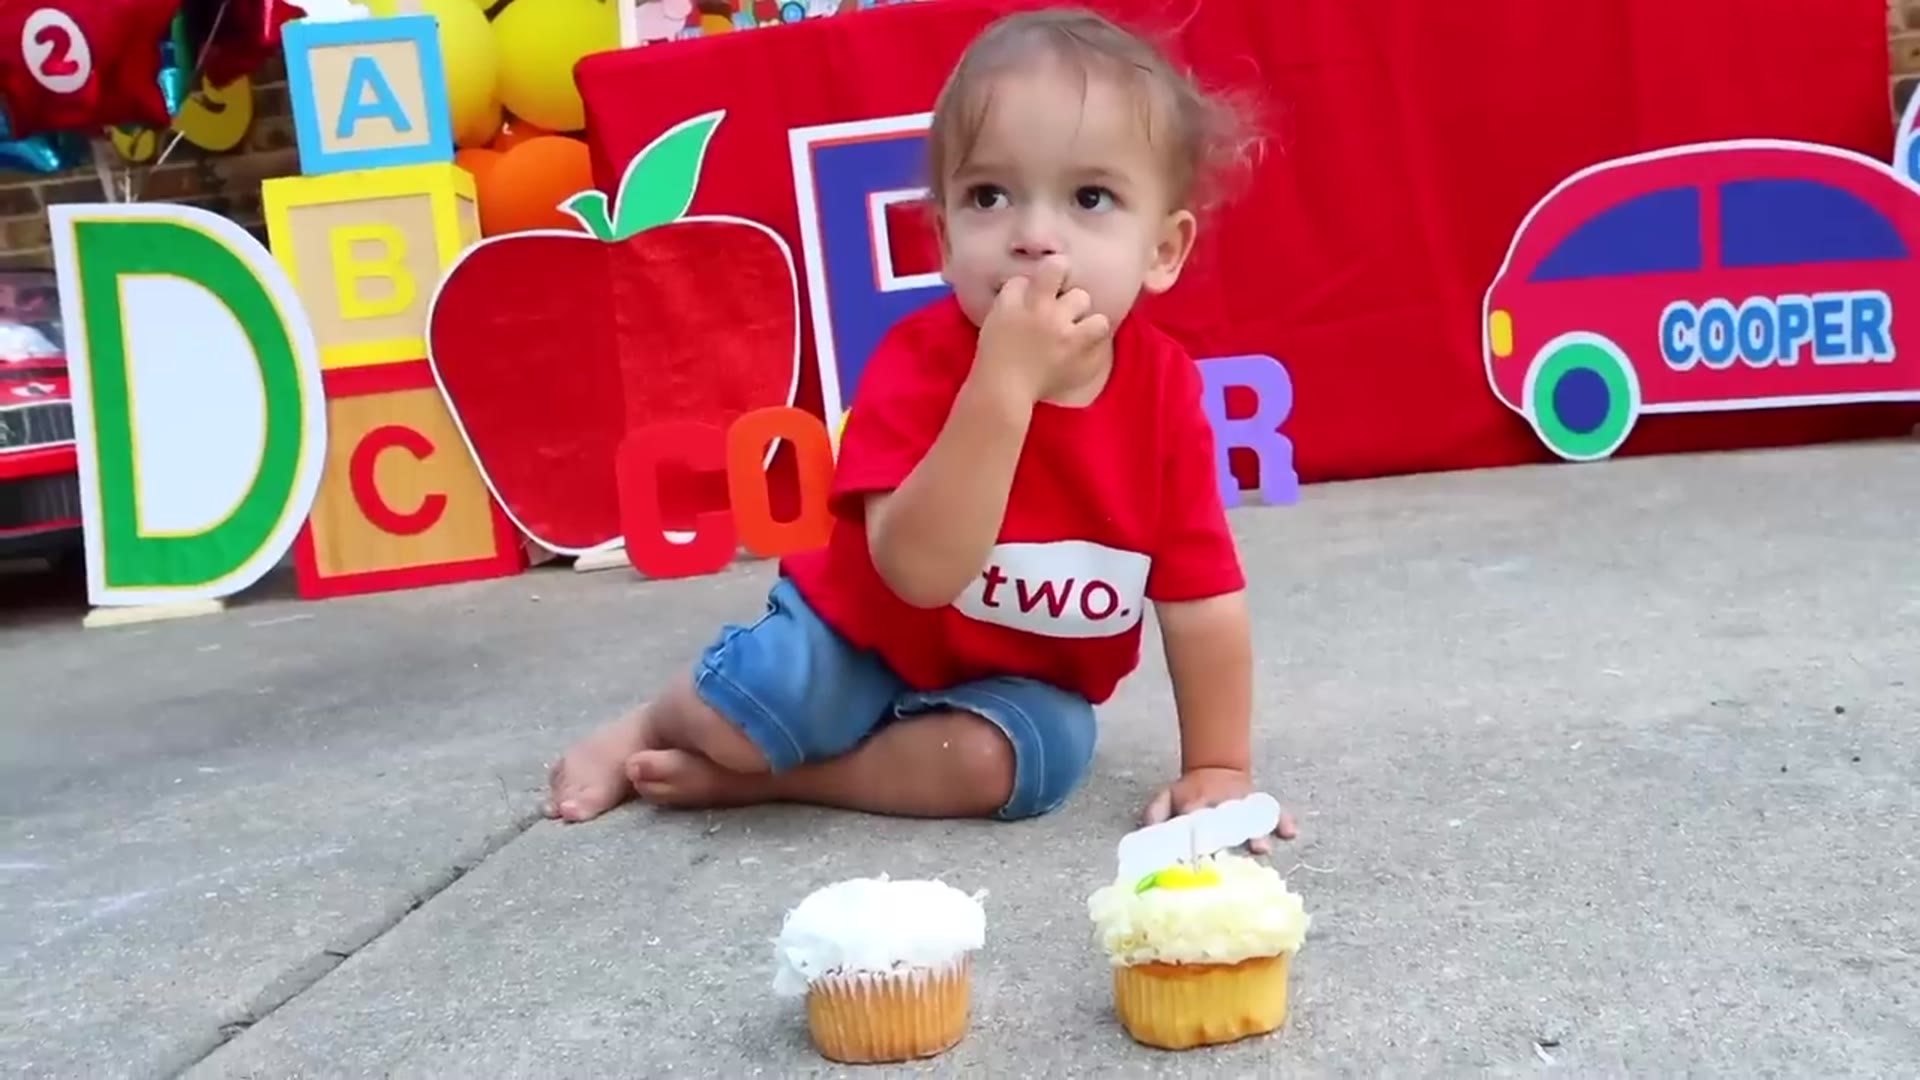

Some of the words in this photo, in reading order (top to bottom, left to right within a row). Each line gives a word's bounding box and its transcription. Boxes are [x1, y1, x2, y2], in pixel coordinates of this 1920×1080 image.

[35, 25, 78, 76] 2
[336, 56, 412, 139] A
[328, 224, 417, 320] B
[1660, 293, 1893, 367] COOPER
[70, 214, 307, 591] D
[349, 425, 447, 535] C
[982, 564, 1131, 621] two.
